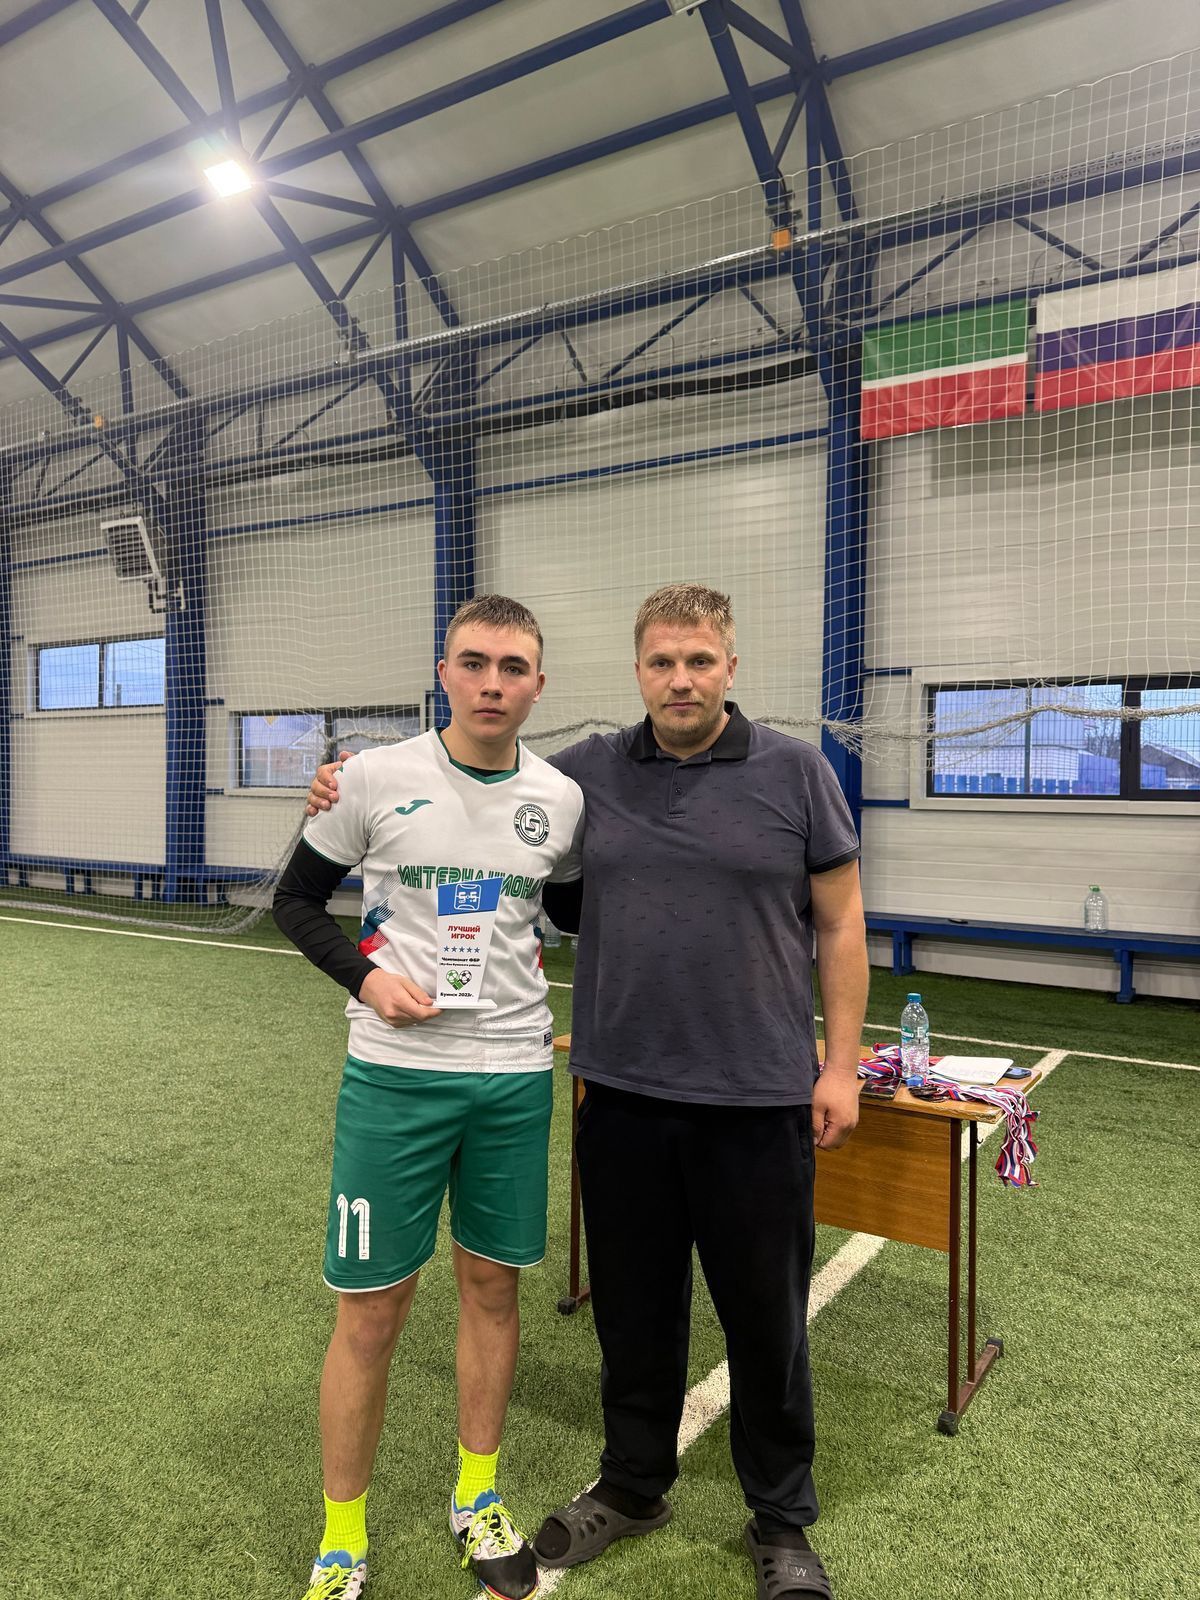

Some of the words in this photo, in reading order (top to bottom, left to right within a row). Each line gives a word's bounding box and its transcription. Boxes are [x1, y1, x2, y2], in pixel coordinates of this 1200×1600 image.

[397, 864, 545, 899] ИНТЕРНИОН
[447, 925, 481, 933] ЛУЧШИЙ
[336, 1193, 370, 1260] 11
